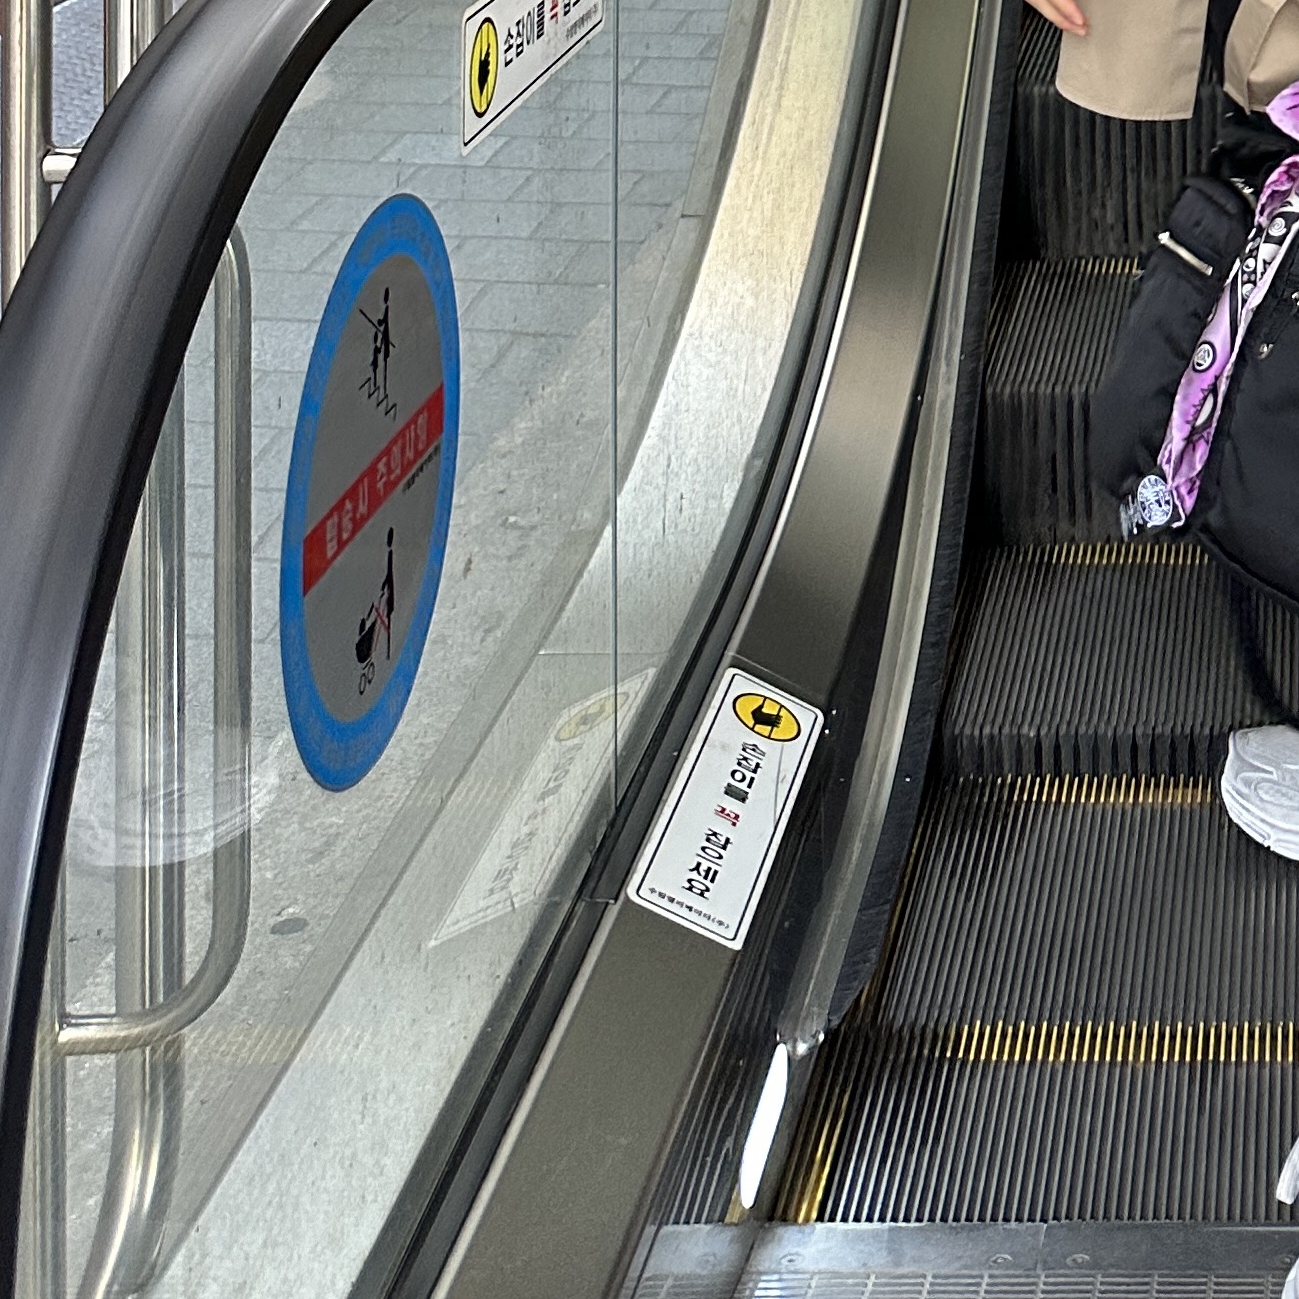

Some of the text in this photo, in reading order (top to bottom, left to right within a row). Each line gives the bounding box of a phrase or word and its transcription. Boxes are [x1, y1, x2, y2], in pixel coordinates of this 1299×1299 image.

[503, 0, 546, 68] 손잡이를
[682, 741, 766, 900] 손잡이를 꼭 잡으세요
